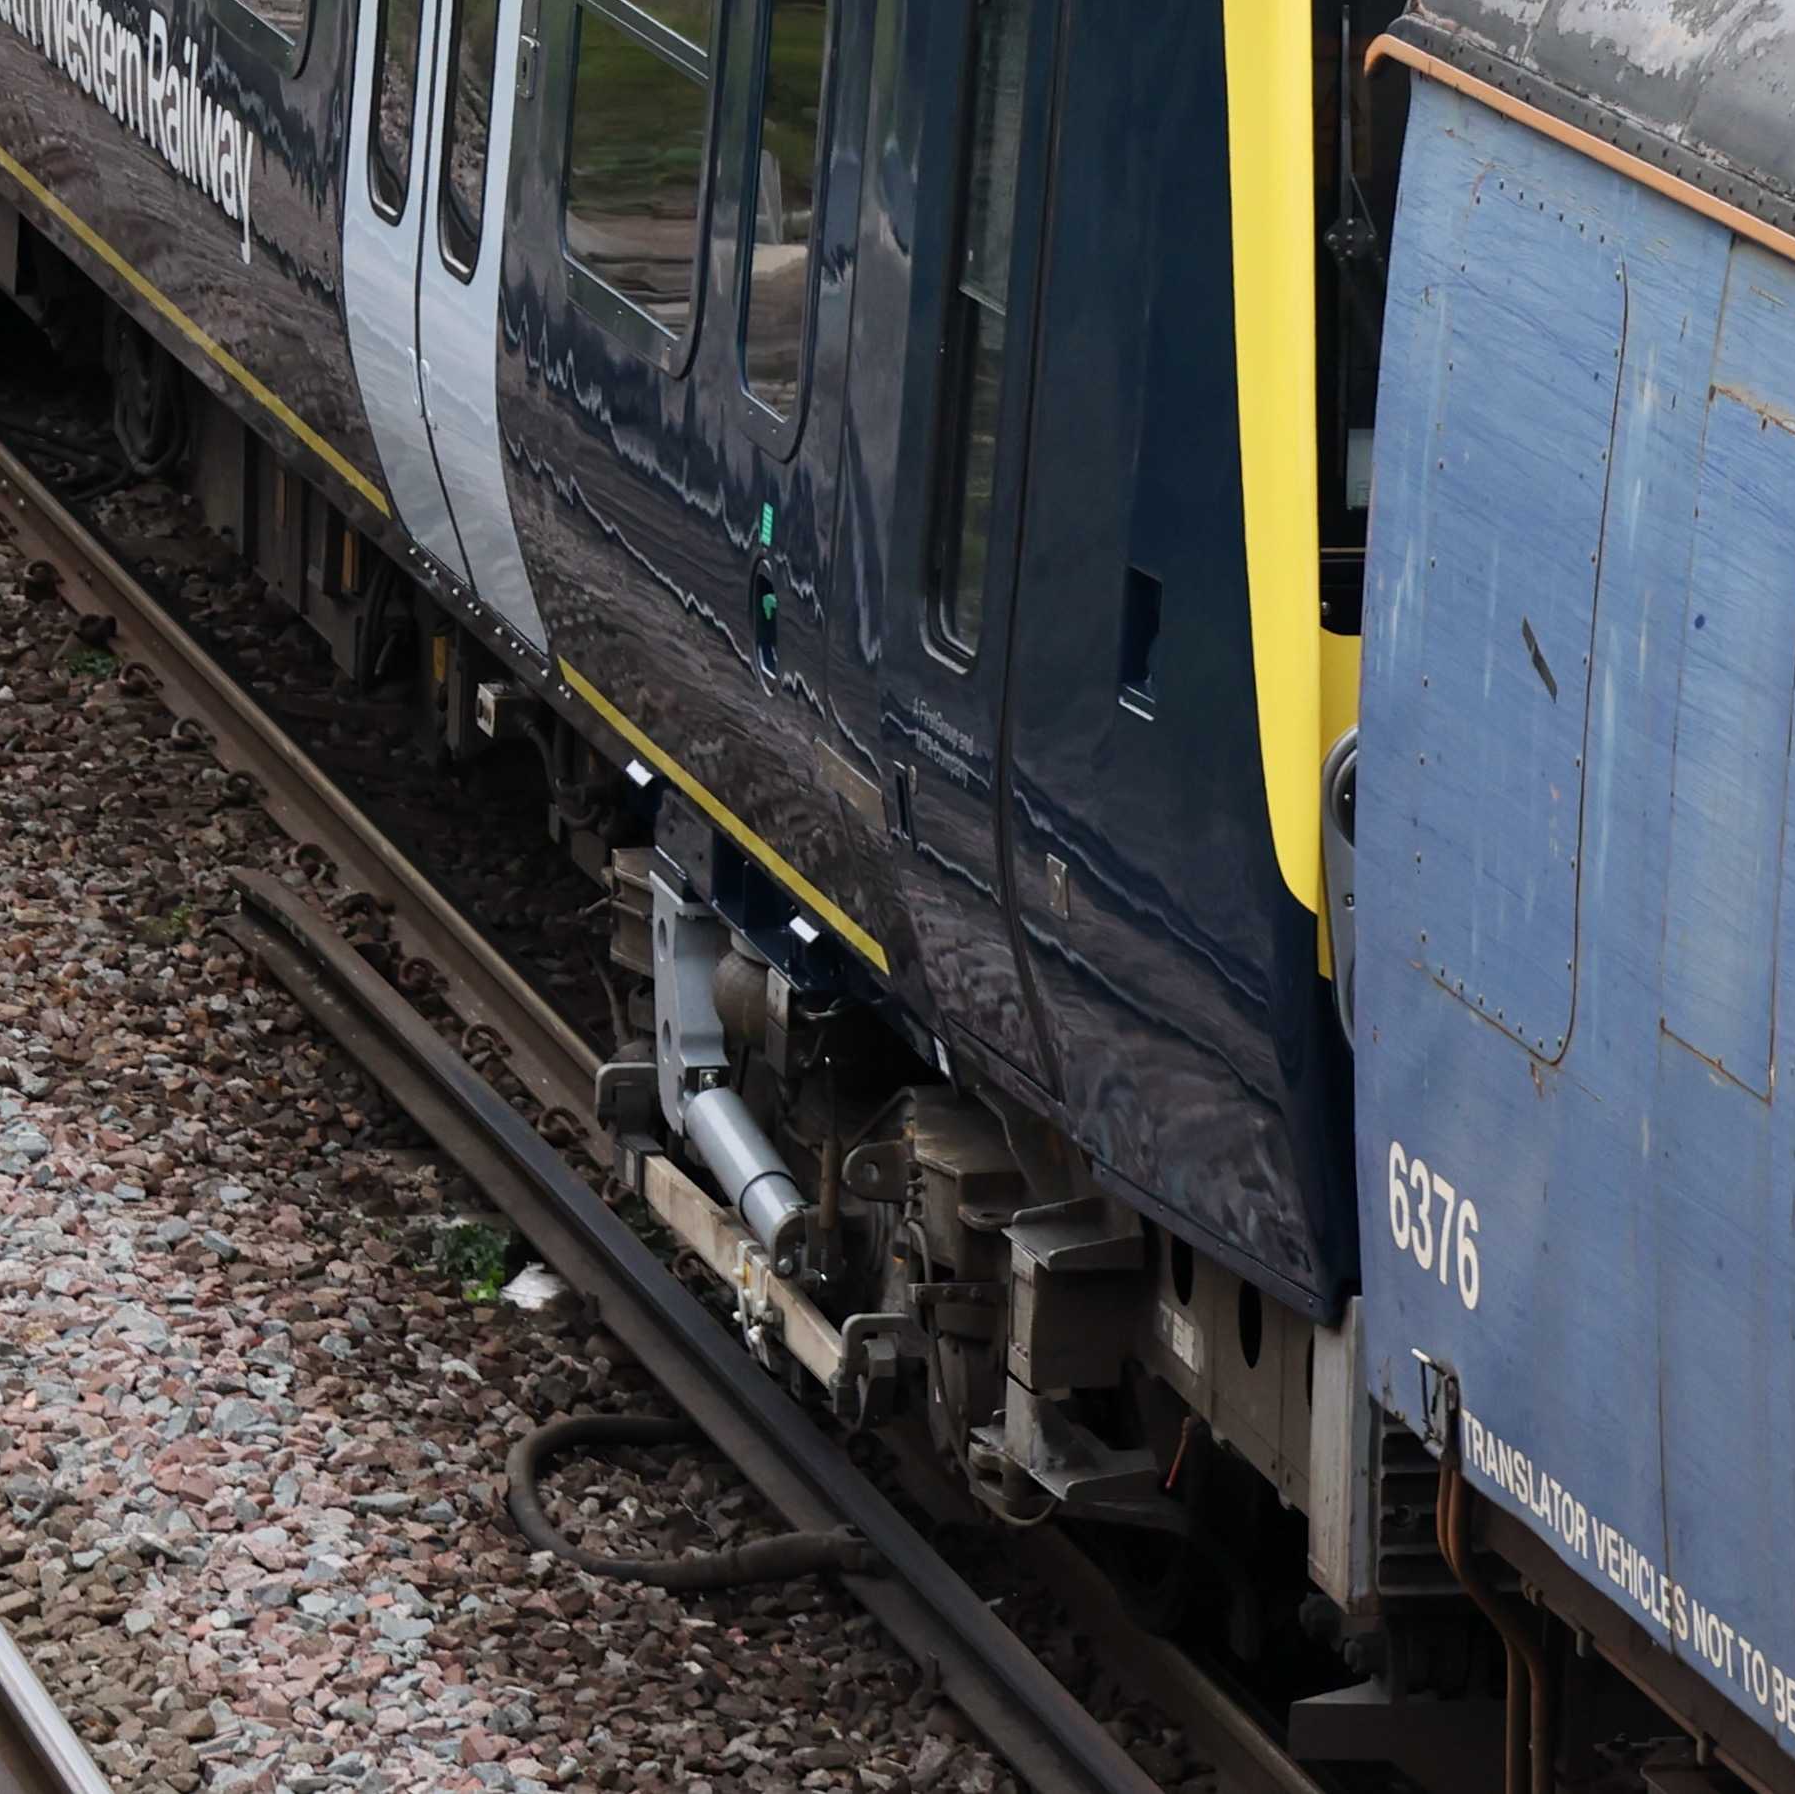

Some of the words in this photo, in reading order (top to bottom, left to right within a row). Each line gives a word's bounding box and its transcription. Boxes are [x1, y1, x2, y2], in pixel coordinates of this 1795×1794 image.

[147, 9, 254, 265] Railway
[1388, 1141, 1480, 1311] 6376
[1460, 1408, 1588, 1560] TRANSLATOR
[1591, 1516, 1689, 1641] VEHICLES
[1692, 1599, 1735, 1679] NOT
[1738, 1636, 1769, 1706] TO
